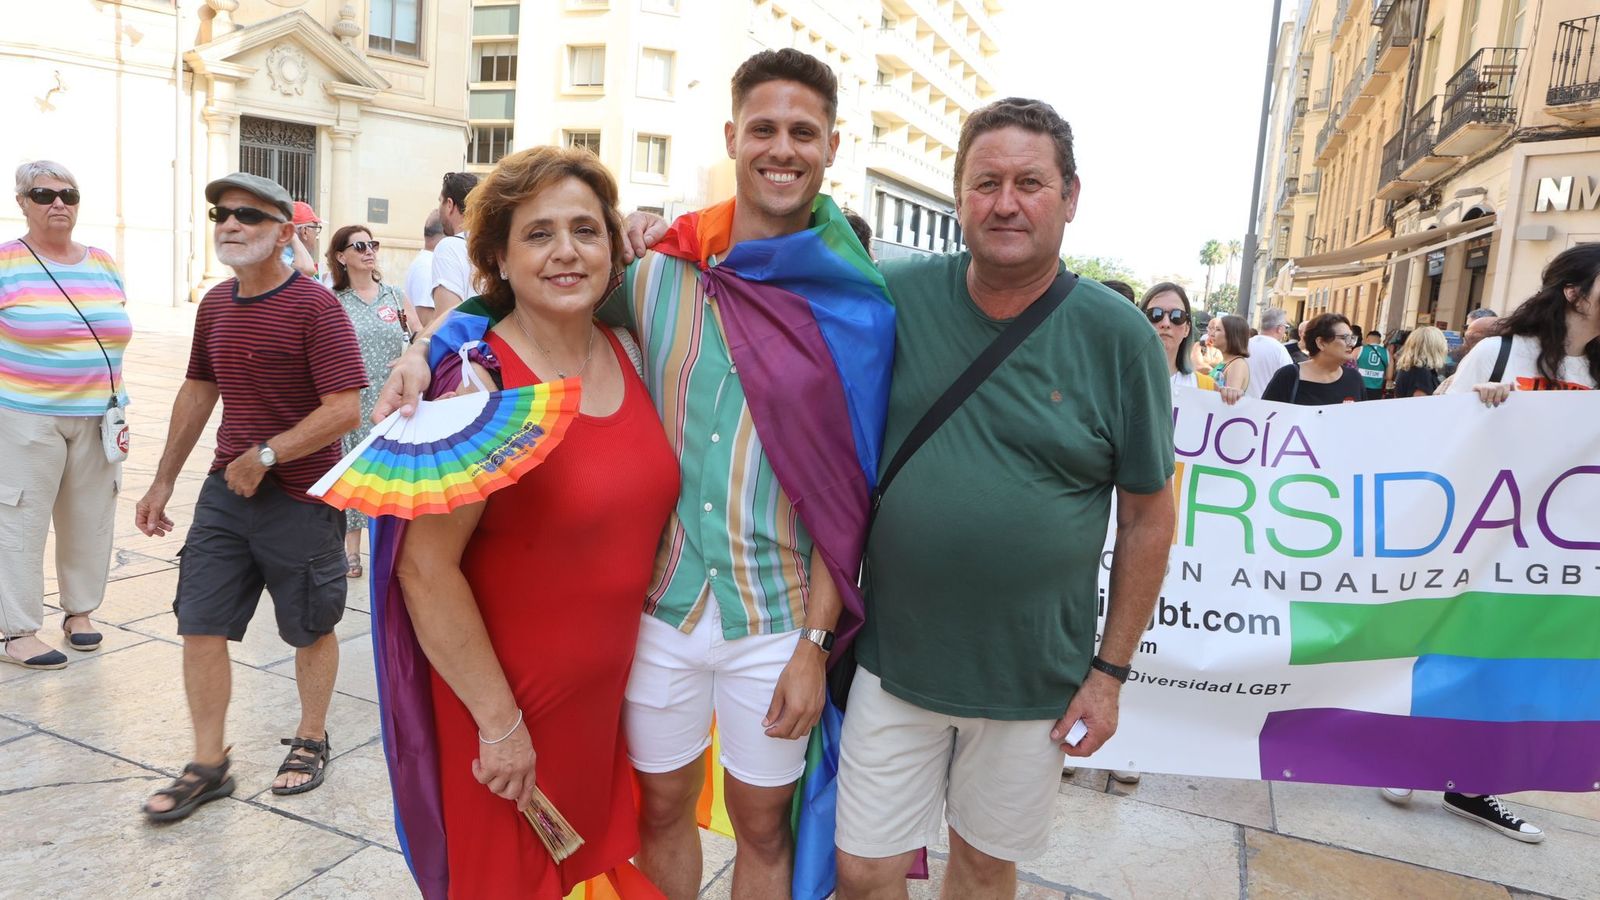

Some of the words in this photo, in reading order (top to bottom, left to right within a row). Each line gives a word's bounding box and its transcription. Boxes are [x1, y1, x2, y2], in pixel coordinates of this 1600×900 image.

[1230, 567, 1470, 594] ANDALUZA
[1494, 562, 1600, 585] LGB
[1127, 670, 1233, 693] Diversidad
[1236, 683, 1291, 696] LGBT
